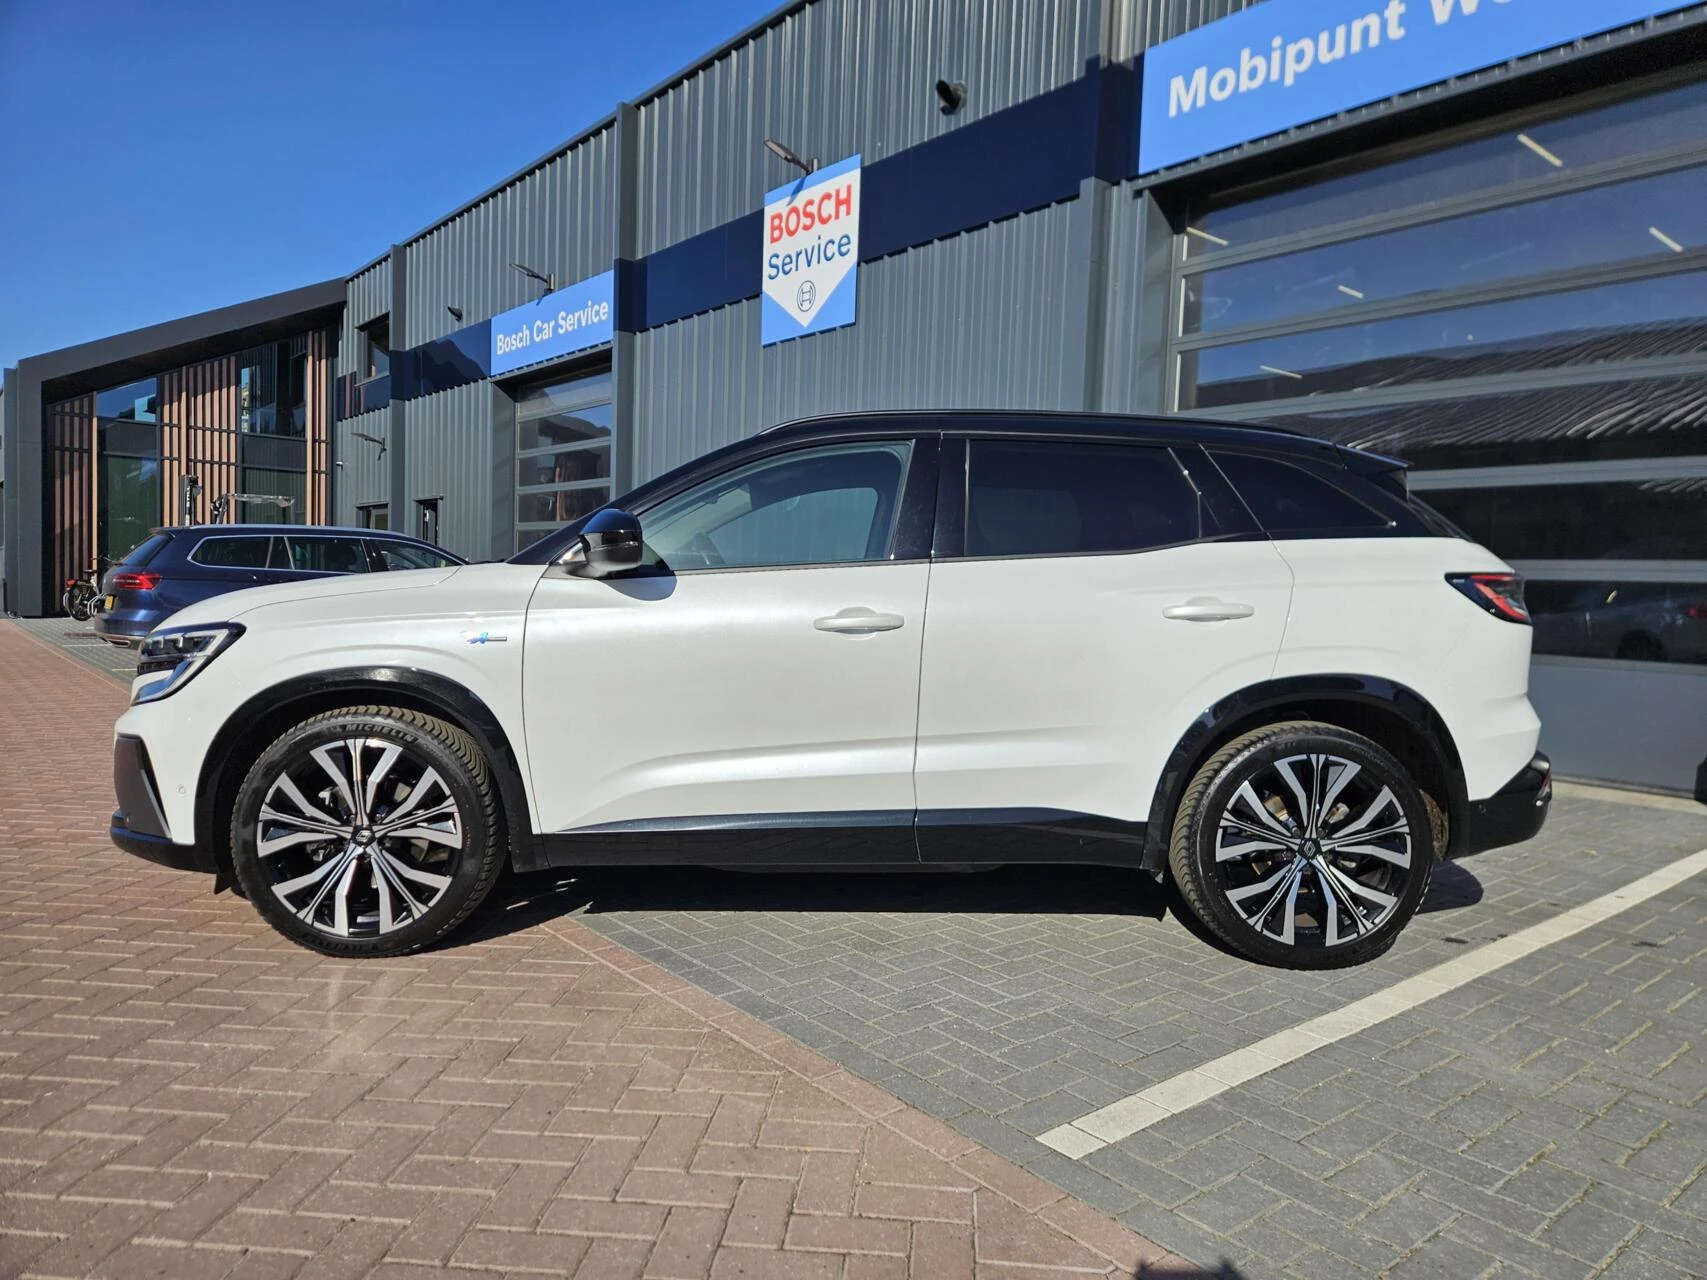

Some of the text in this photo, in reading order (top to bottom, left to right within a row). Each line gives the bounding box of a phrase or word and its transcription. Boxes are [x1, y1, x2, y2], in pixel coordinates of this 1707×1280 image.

[1169, 0, 1406, 117] Mobipunt
[770, 184, 852, 244] BOSCH
[768, 234, 851, 280] Service
[497, 300, 609, 355] Bosch Car Service
[345, 724, 416, 743] MICHELIN
